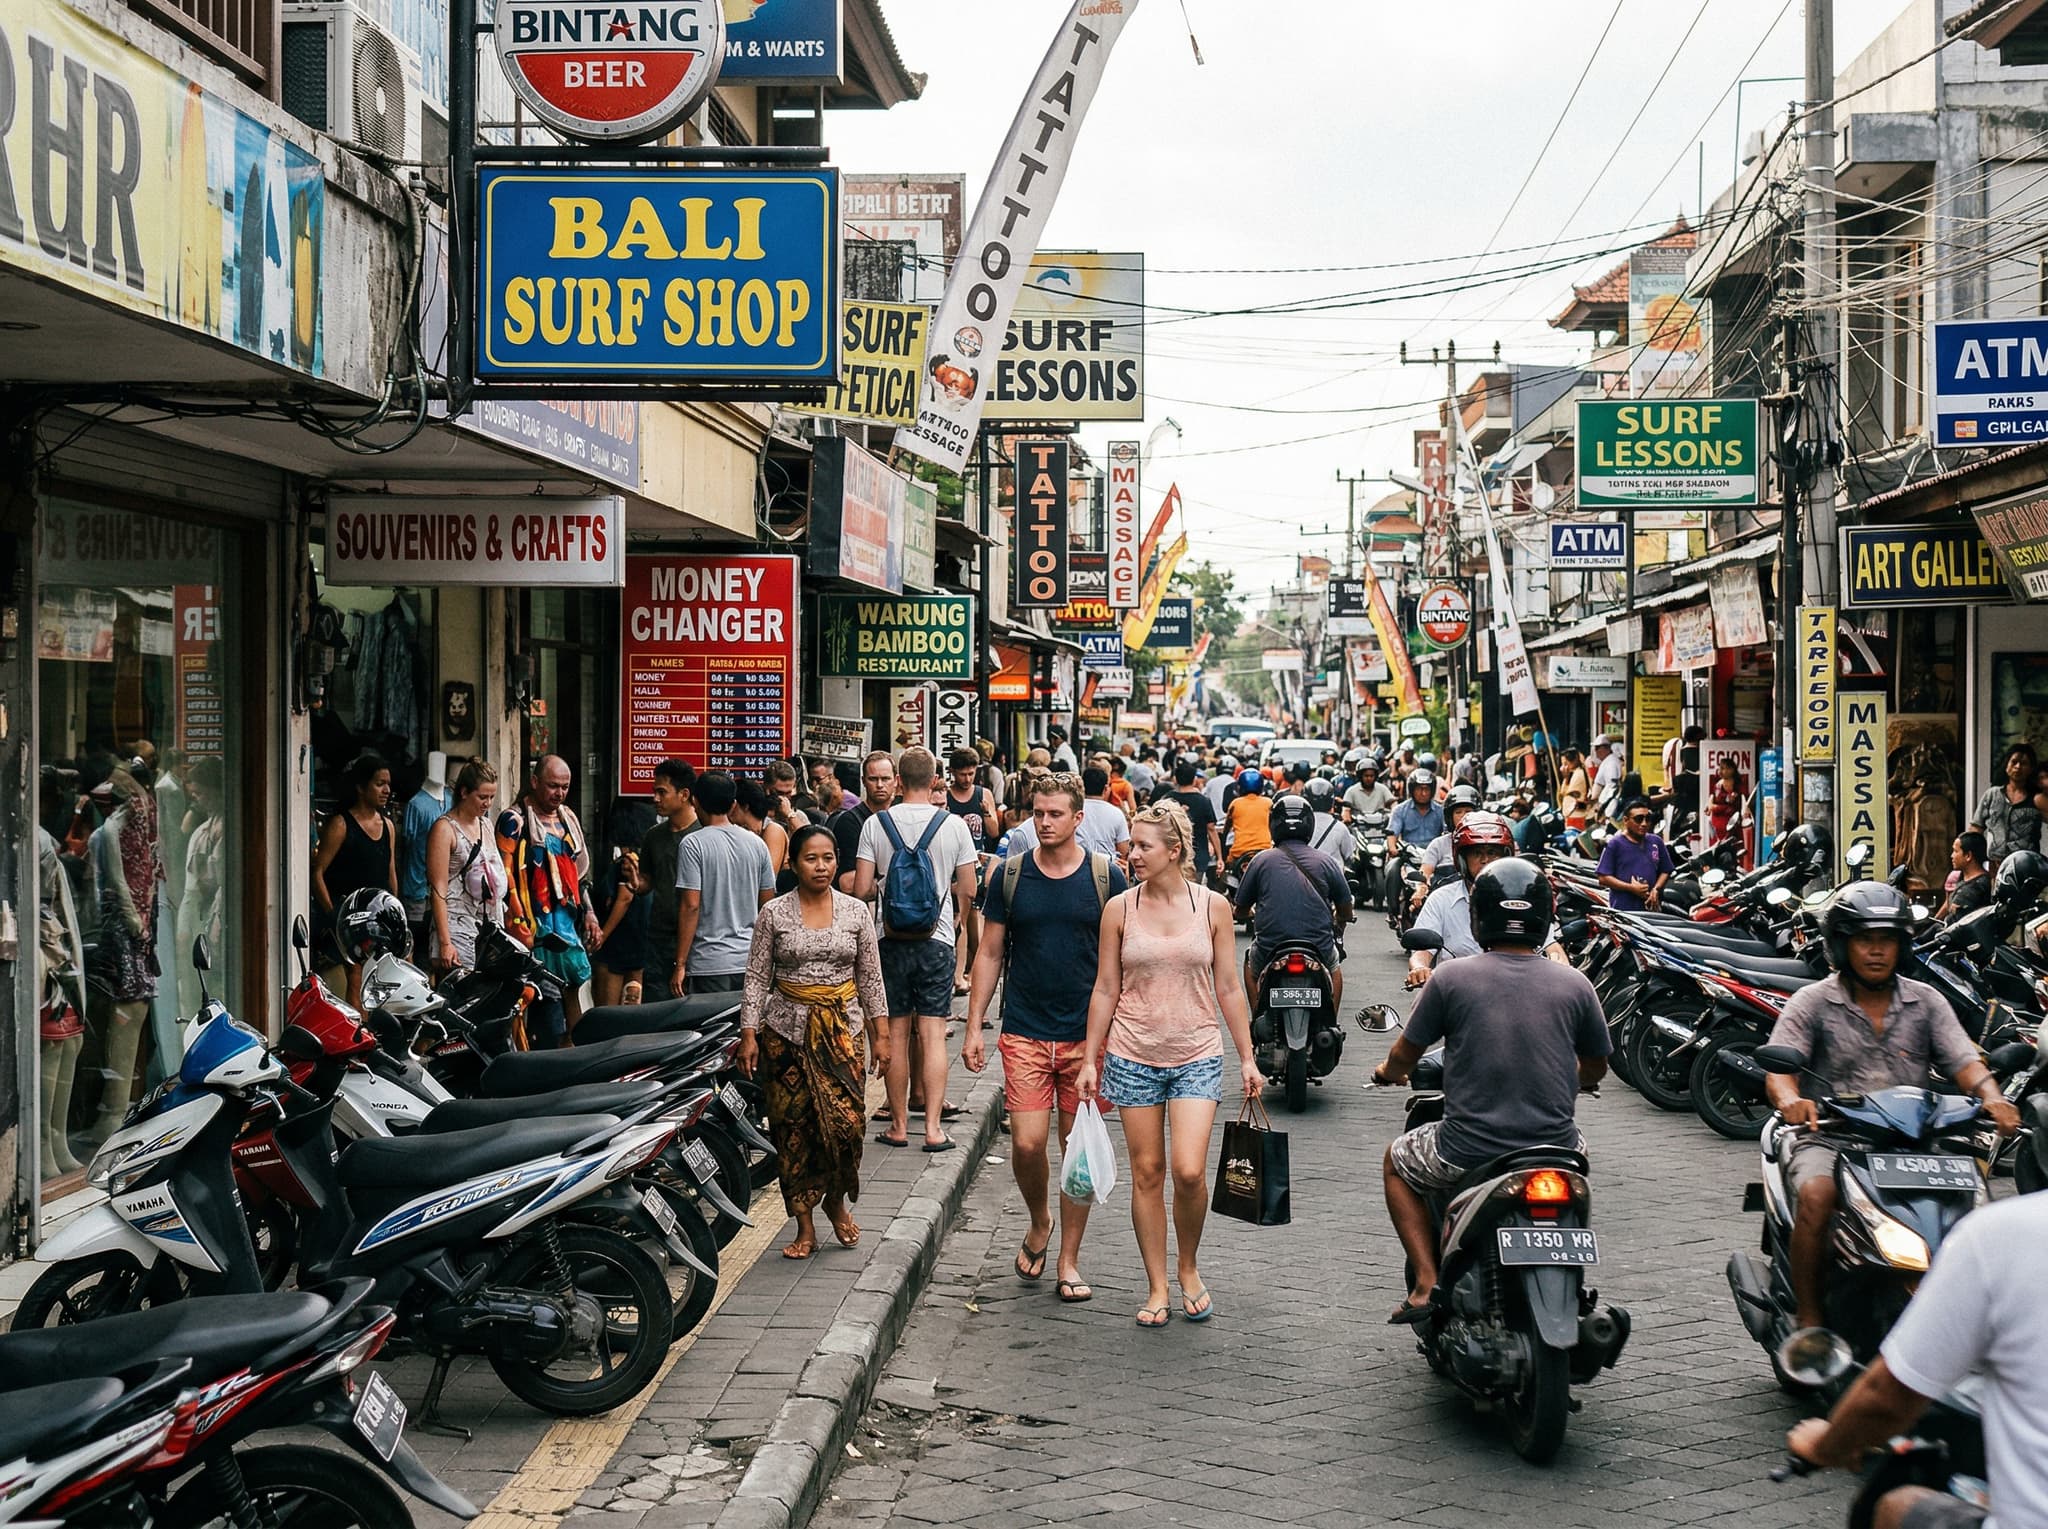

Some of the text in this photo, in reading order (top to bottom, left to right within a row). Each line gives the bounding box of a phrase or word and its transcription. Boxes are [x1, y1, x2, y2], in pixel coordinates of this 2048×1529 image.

[511, 8, 699, 43] BINTANG
[747, 41, 761, 57] &
[764, 41, 826, 57] WARTS
[563, 61, 647, 88] BEER
[966, 21, 1100, 322] TATTOO
[548, 197, 767, 260] BALI
[504, 276, 811, 347] SURF SHOP
[843, 307, 924, 357] SURF
[1953, 336, 2048, 380] ATM
[985, 358, 1138, 403] ESSONS
[1616, 405, 1722, 436] SURF
[1596, 440, 1744, 468] LESSONS
[336, 513, 607, 561] SOUVENIRS & CRAFTS
[1028, 446, 1057, 600] TATTOO
[1112, 467, 1136, 602] MASSAGE
[1556, 527, 1620, 551] ATM
[1856, 542, 1905, 591] ART
[651, 566, 766, 602] MONEY
[630, 606, 785, 642] CHANGER
[857, 602, 965, 626] WARUNG
[1420, 610, 1470, 622] BINTANG
[857, 630, 965, 654] BAMBOO
[1085, 637, 1120, 653] ATM
[634, 673, 666, 681] MONEY
[650, 659, 685, 667] NAMES
[857, 658, 965, 673] RESTAURANT
[1807, 613, 1831, 748] TARFEOGN
[126, 1196, 166, 1213] YAMAHA
[1501, 1231, 1512, 1248] R
[1523, 1231, 1564, 1248] 1350
